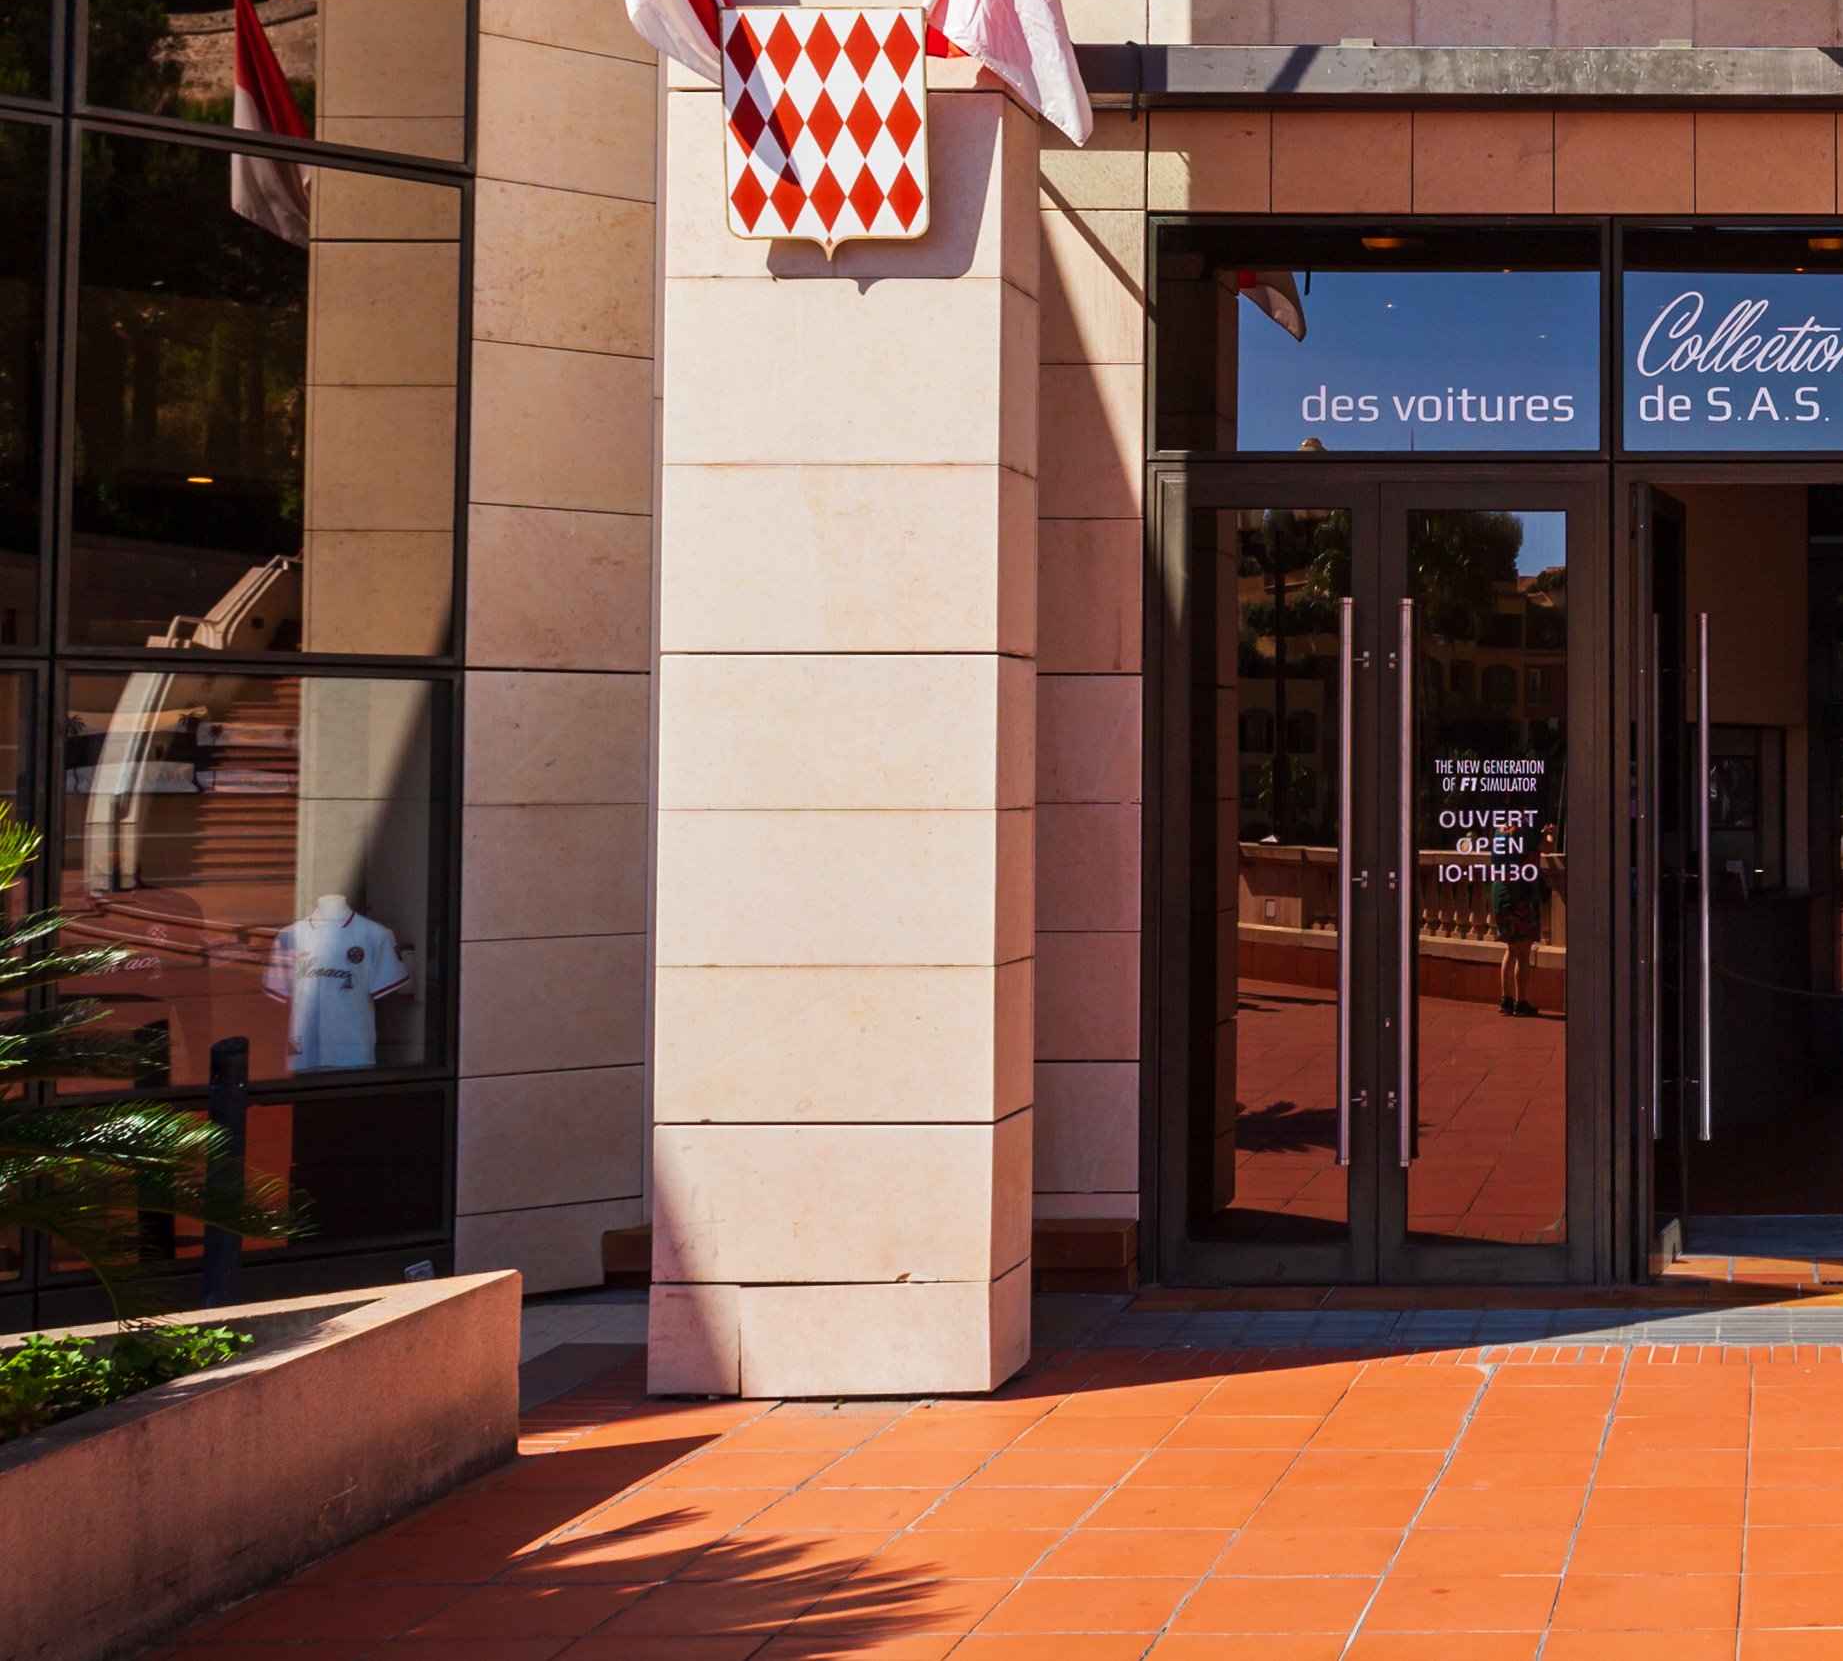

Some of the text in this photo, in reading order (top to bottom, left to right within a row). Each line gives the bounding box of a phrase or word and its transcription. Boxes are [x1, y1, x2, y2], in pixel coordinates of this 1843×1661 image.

[1302, 385, 1575, 422] des voitures
[1639, 385, 1692, 422] de
[1707, 386, 1830, 422] S.A.S.
[1435, 759, 1545, 775] THE NEW GENERATION
[1442, 777, 1537, 792] OF F1 SIMULATOR
[1438, 810, 1538, 828] OUVERT
[1456, 836, 1524, 855] OPEN
